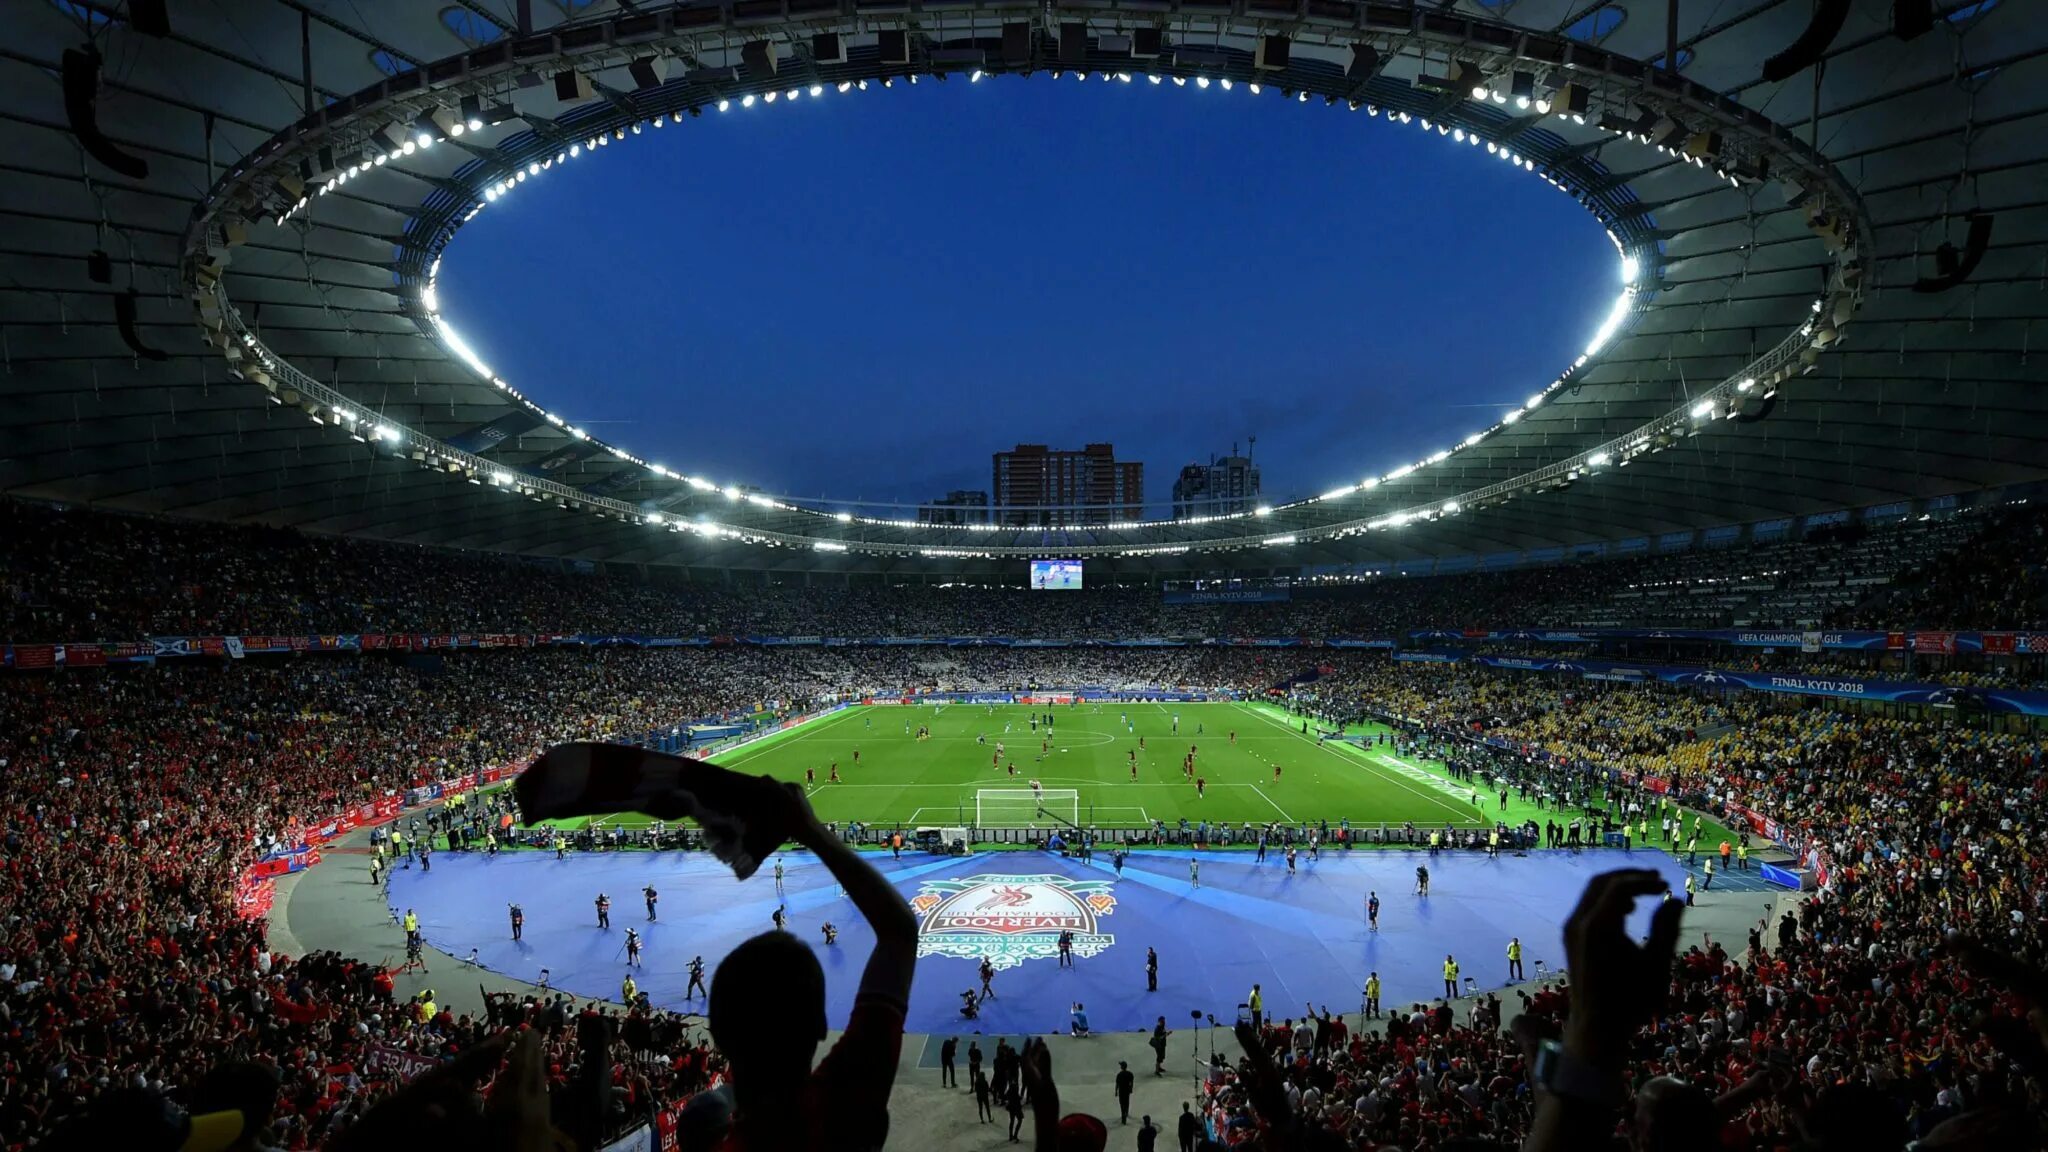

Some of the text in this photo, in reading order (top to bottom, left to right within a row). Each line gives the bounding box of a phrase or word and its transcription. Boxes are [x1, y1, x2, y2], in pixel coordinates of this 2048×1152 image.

[1191, 592, 1218, 600] FINAL
[1220, 591, 1242, 599] KYIV
[1738, 633, 1758, 642] UEFA
[1759, 633, 1802, 643] CHAMPION
[1498, 657, 1510, 665] FINAL
[1511, 658, 1521, 666] KYIV
[1771, 677, 1864, 694] FINAL KYIV 2018
[938, 917, 1081, 927] LIVERPOOL
[918, 935, 957, 943] ALON
[960, 935, 1004, 943] WALK
[1010, 935, 1055, 943] NEVER
